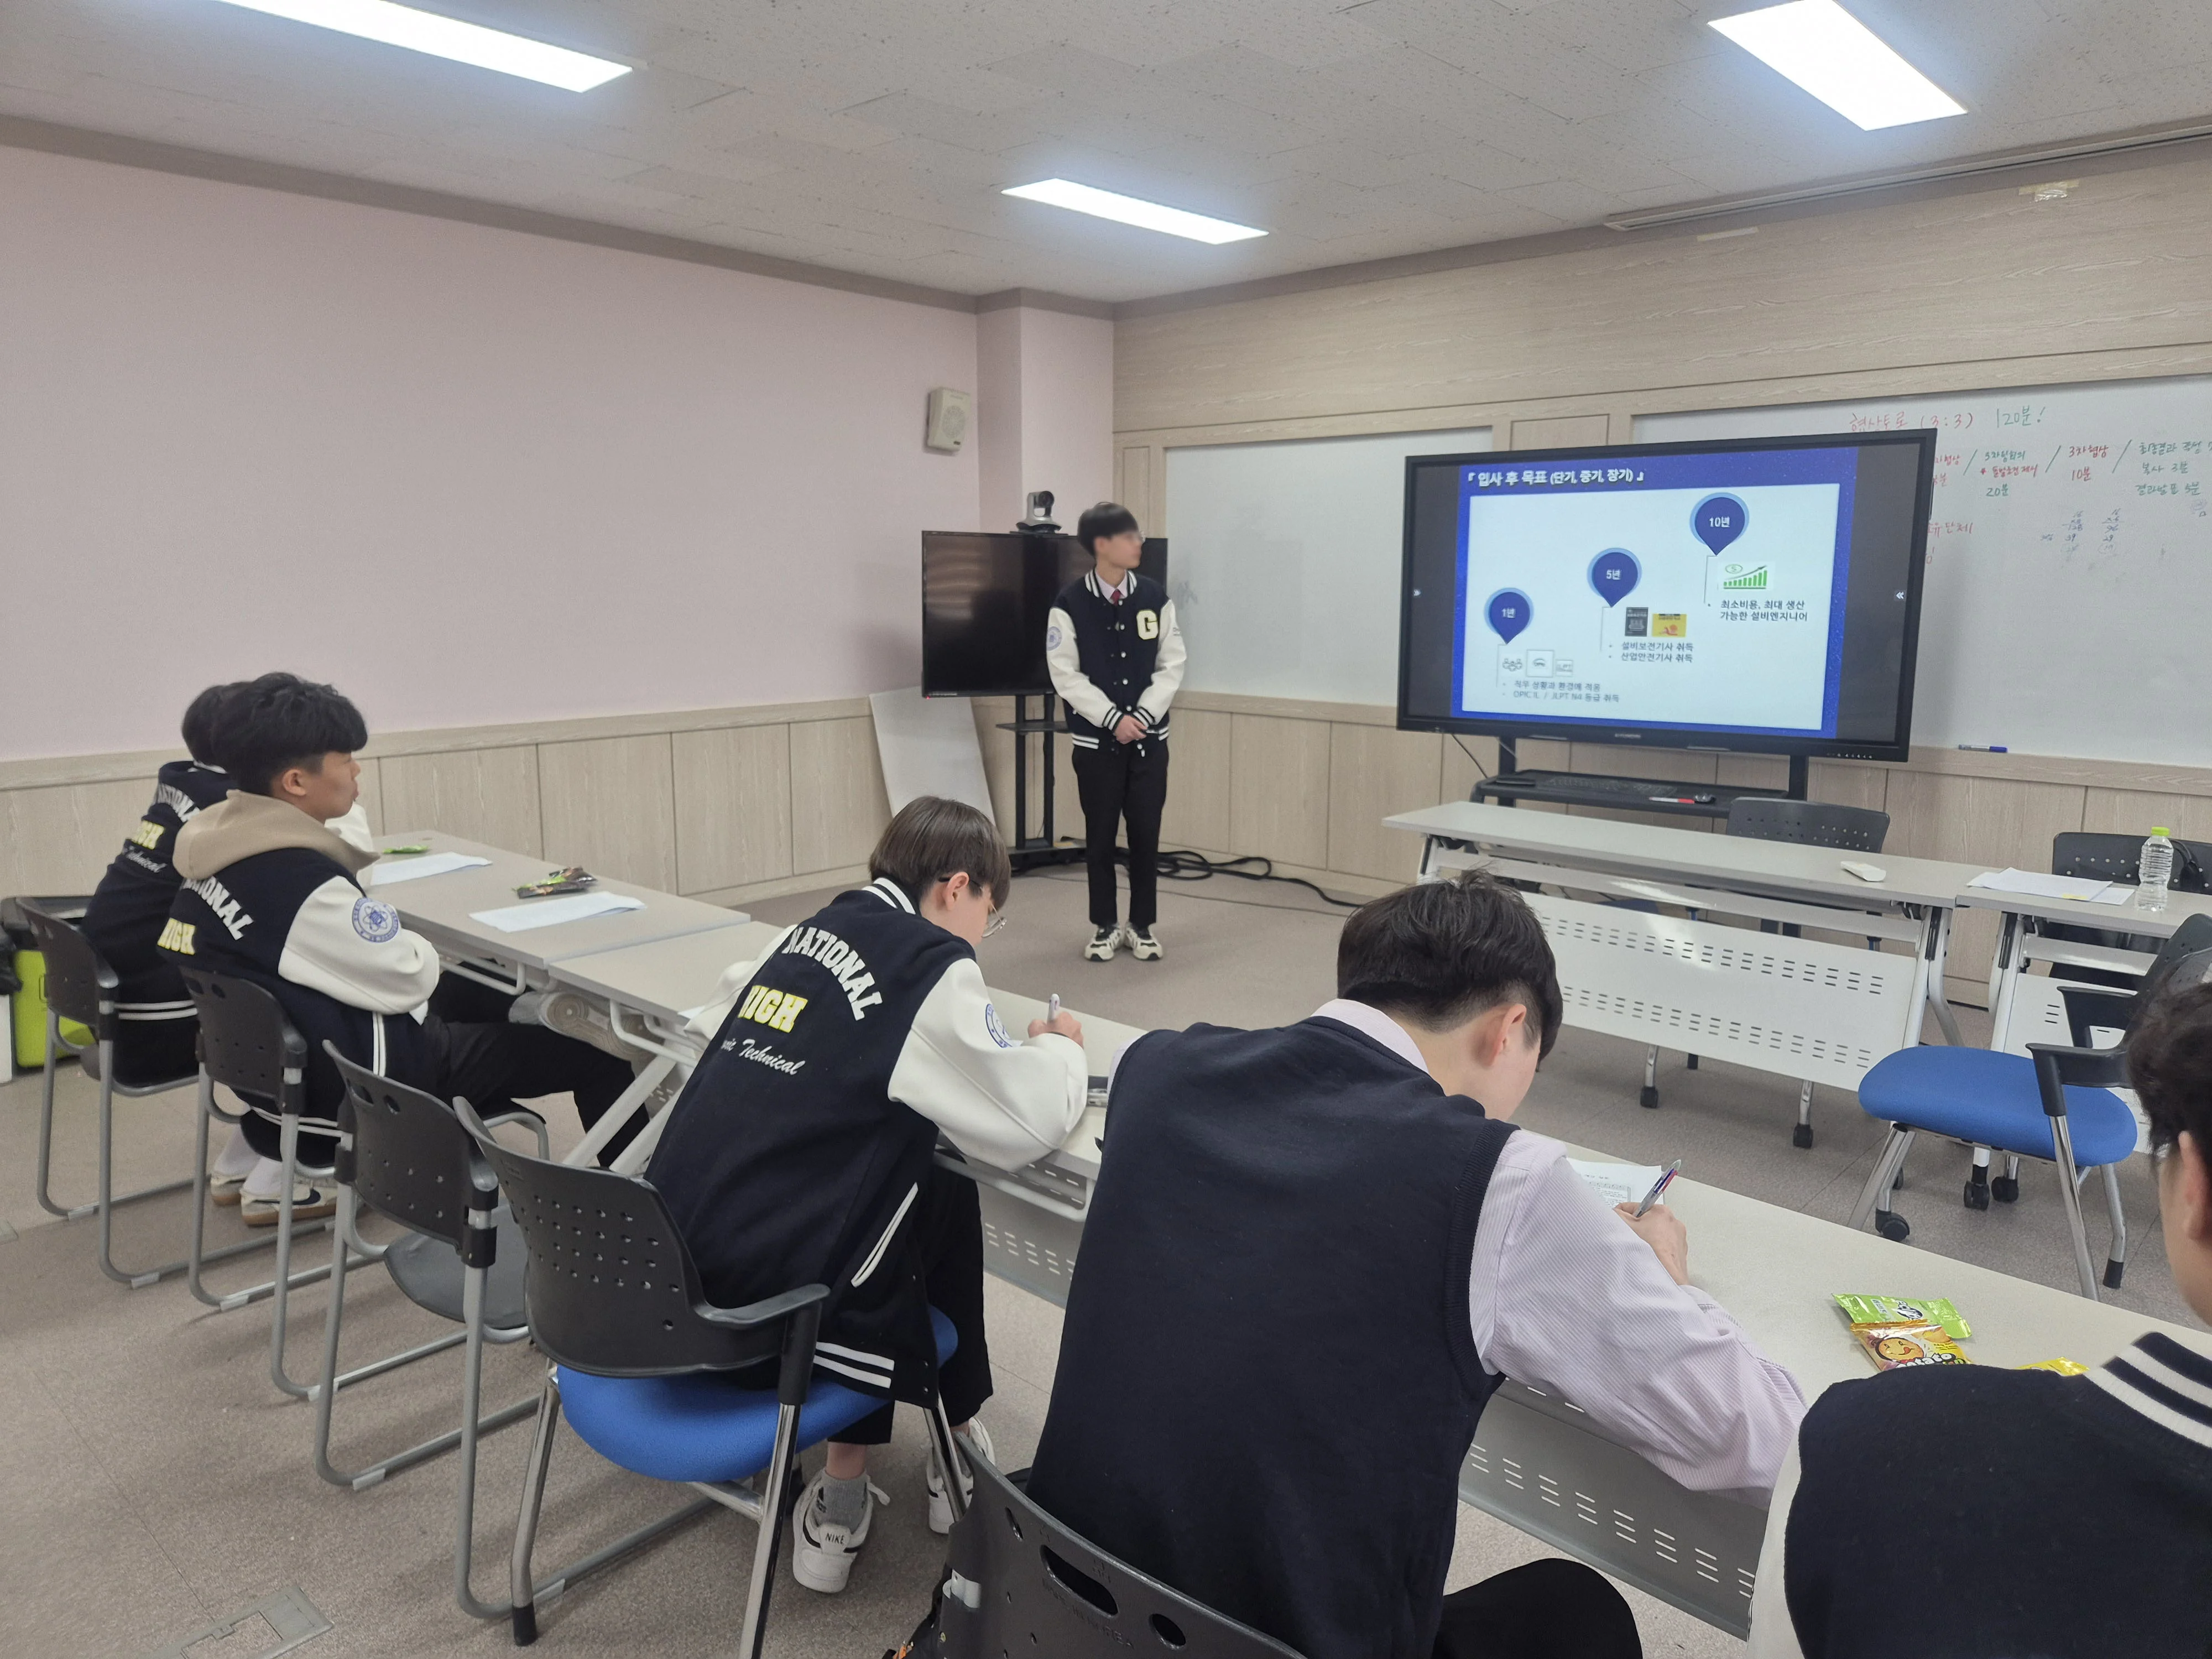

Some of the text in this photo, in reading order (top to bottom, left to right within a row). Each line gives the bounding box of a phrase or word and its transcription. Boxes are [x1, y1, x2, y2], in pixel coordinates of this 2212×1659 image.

[1478, 471, 1503, 487] 입사
[1505, 471, 1519, 486] 후
[1522, 470, 1548, 485] 목표
[1709, 516, 1730, 528] 10년
[1605, 568, 1621, 581] 5년
[1720, 599, 1805, 611] 최소비용, 최대 생산
[1501, 607, 1516, 619] 1년
[1719, 611, 1808, 622] 가능한 설비엔지니어
[1136, 609, 1159, 640] G
[1676, 641, 1694, 652] 취득
[1621, 652, 1694, 664] 산업안전기사 취득
[1584, 693, 1601, 702] 등급
[781, 926, 883, 1021] NATIONAL
[739, 1039, 806, 1076] Technical
[825, 1532, 846, 1545] NIKE
